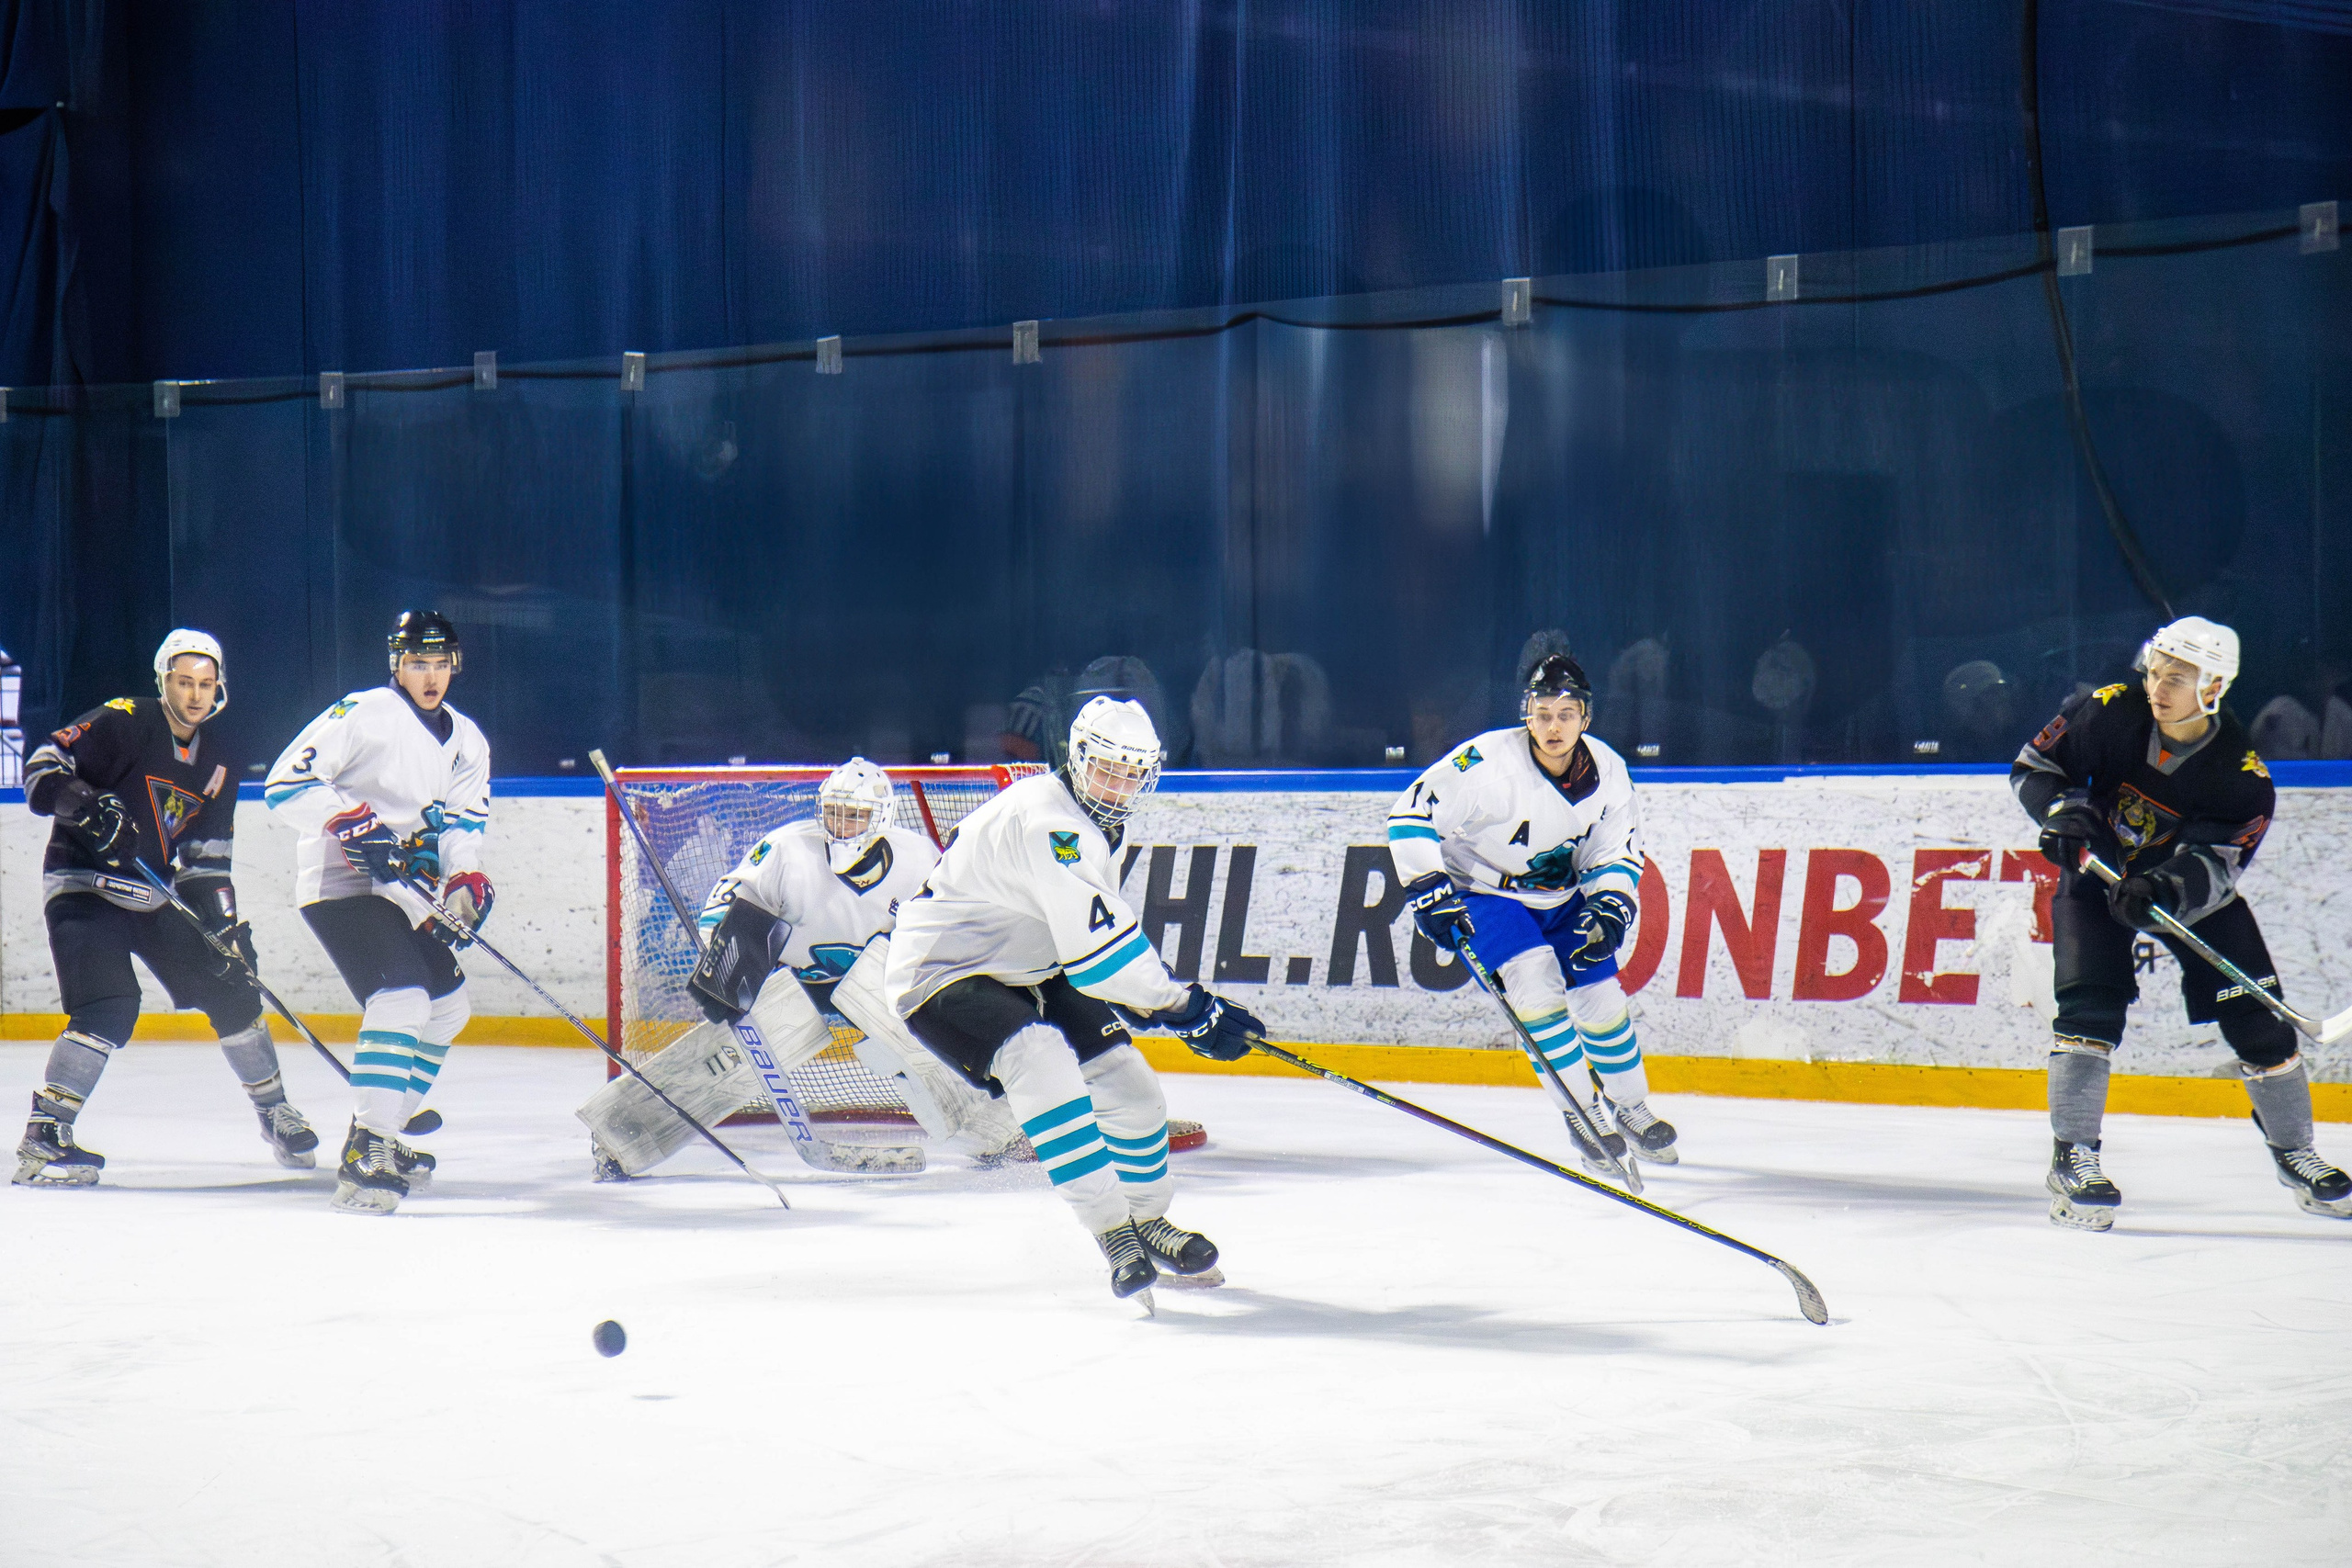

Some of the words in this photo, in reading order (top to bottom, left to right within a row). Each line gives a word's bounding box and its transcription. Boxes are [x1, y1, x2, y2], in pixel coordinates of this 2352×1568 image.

[292, 746, 317, 774] 3
[1508, 819, 1531, 847] A
[1088, 893, 1115, 933] 4
[1408, 881, 1454, 914] CCM
[1119, 844, 1472, 992] HL.RU
[1614, 849, 2062, 1005] ONBET
[2216, 975, 2278, 1003] BAER
[737, 1025, 814, 1142] BAUER
